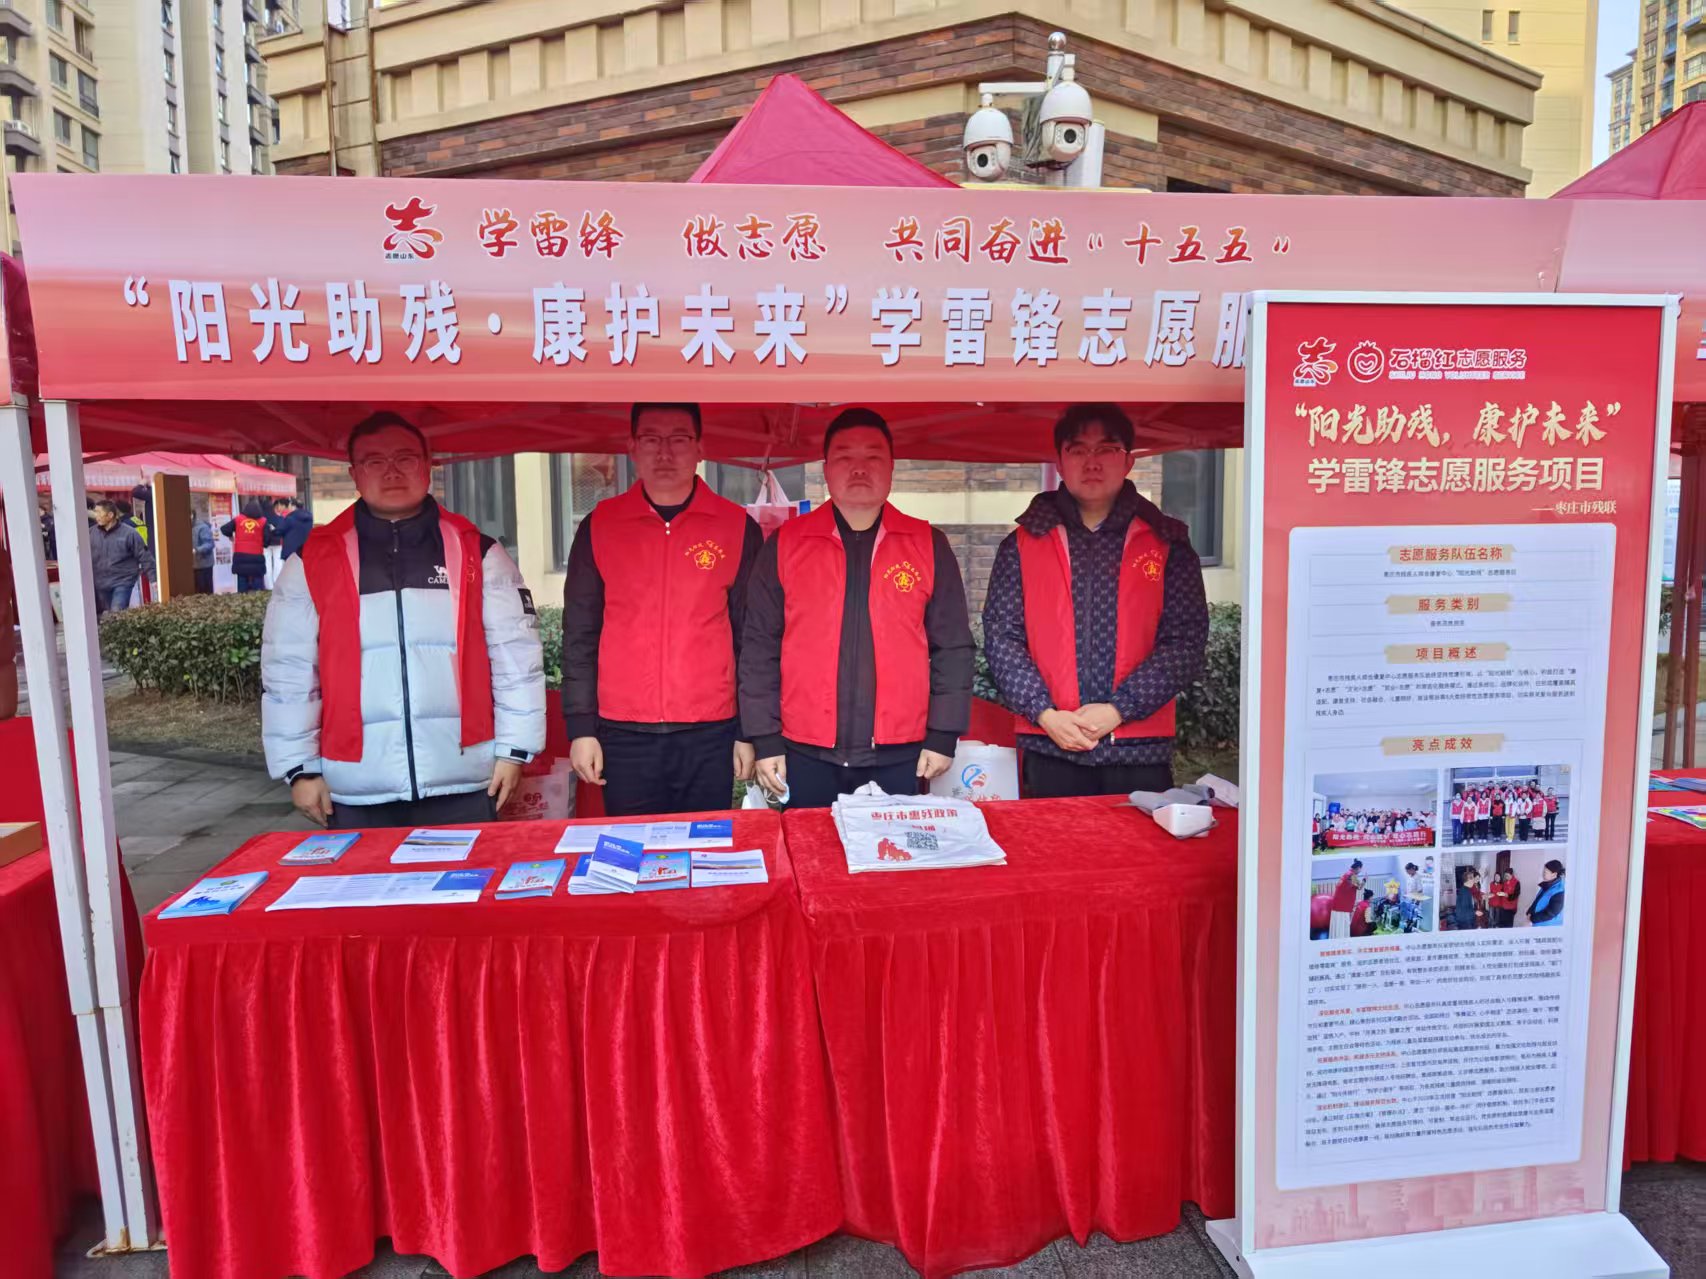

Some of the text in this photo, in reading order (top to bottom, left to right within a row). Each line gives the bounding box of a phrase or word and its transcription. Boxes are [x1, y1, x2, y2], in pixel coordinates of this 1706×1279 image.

[477, 208, 625, 260] 学雷锋
[682, 213, 828, 261] 做志愿
[1388, 347, 1528, 370] 石榴红志愿服务
[1307, 457, 1605, 494] 学雷锋志愿服务项目
[1400, 547, 1503, 562] 志愿服务队伍名称
[1418, 597, 1480, 611] 服务类别
[1416, 646, 1477, 660] 项目概述
[1412, 737, 1473, 752] 亮点成效
